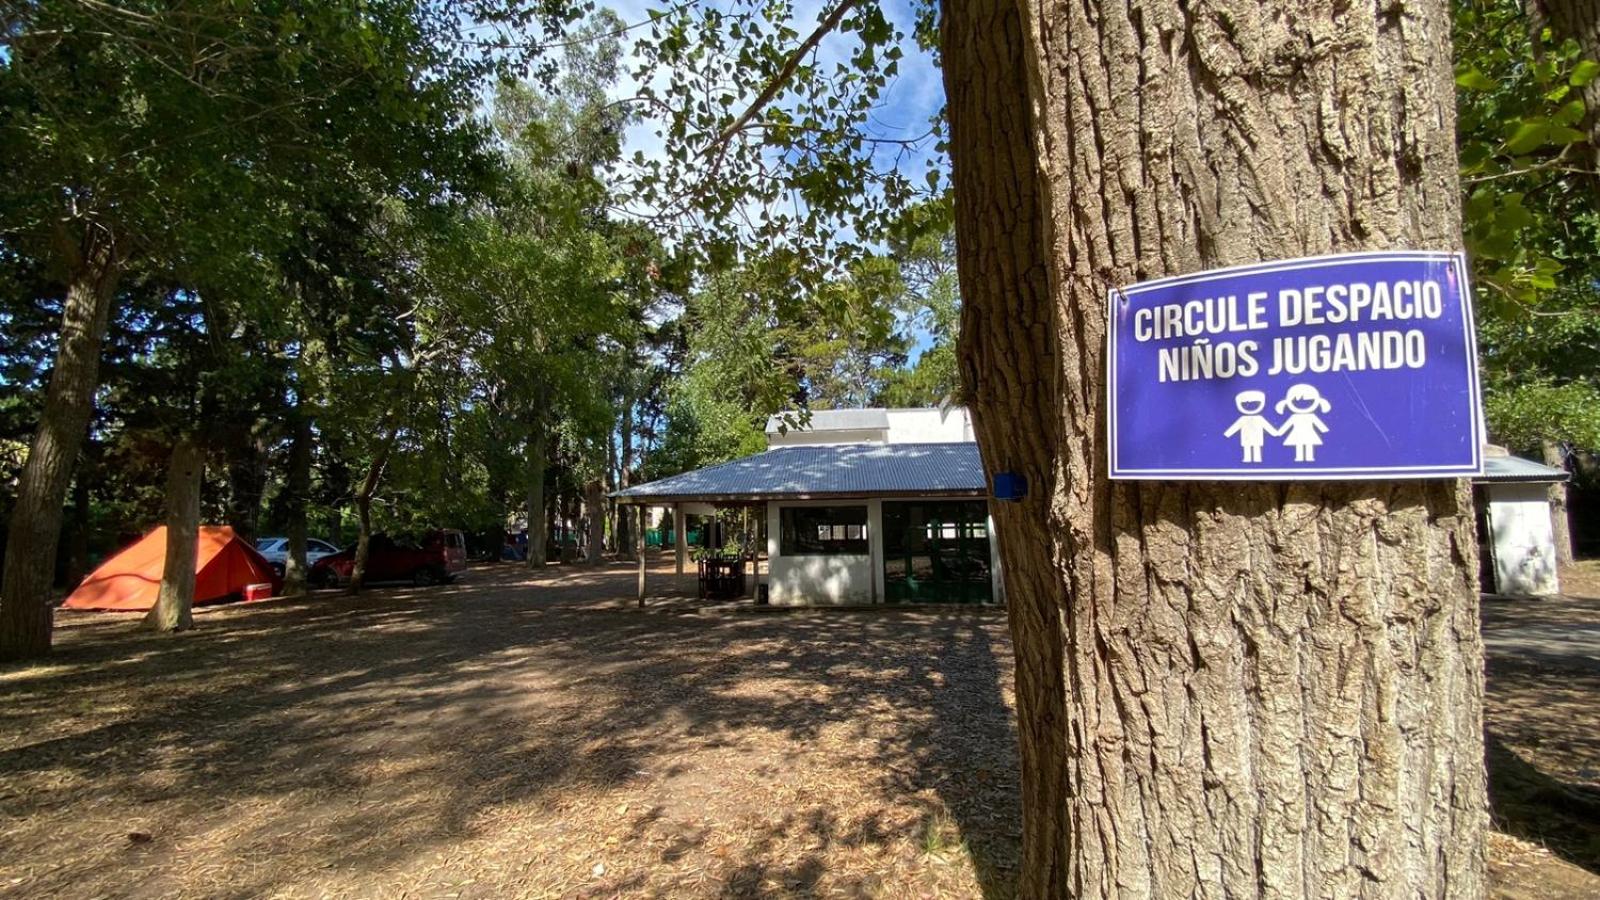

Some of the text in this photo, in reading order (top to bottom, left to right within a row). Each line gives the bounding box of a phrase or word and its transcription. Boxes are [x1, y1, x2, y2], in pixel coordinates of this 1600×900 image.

[1135, 281, 1442, 342] CIRCULE DESPACIO
[1158, 330, 1426, 382] NIÑOS JUGANDO
